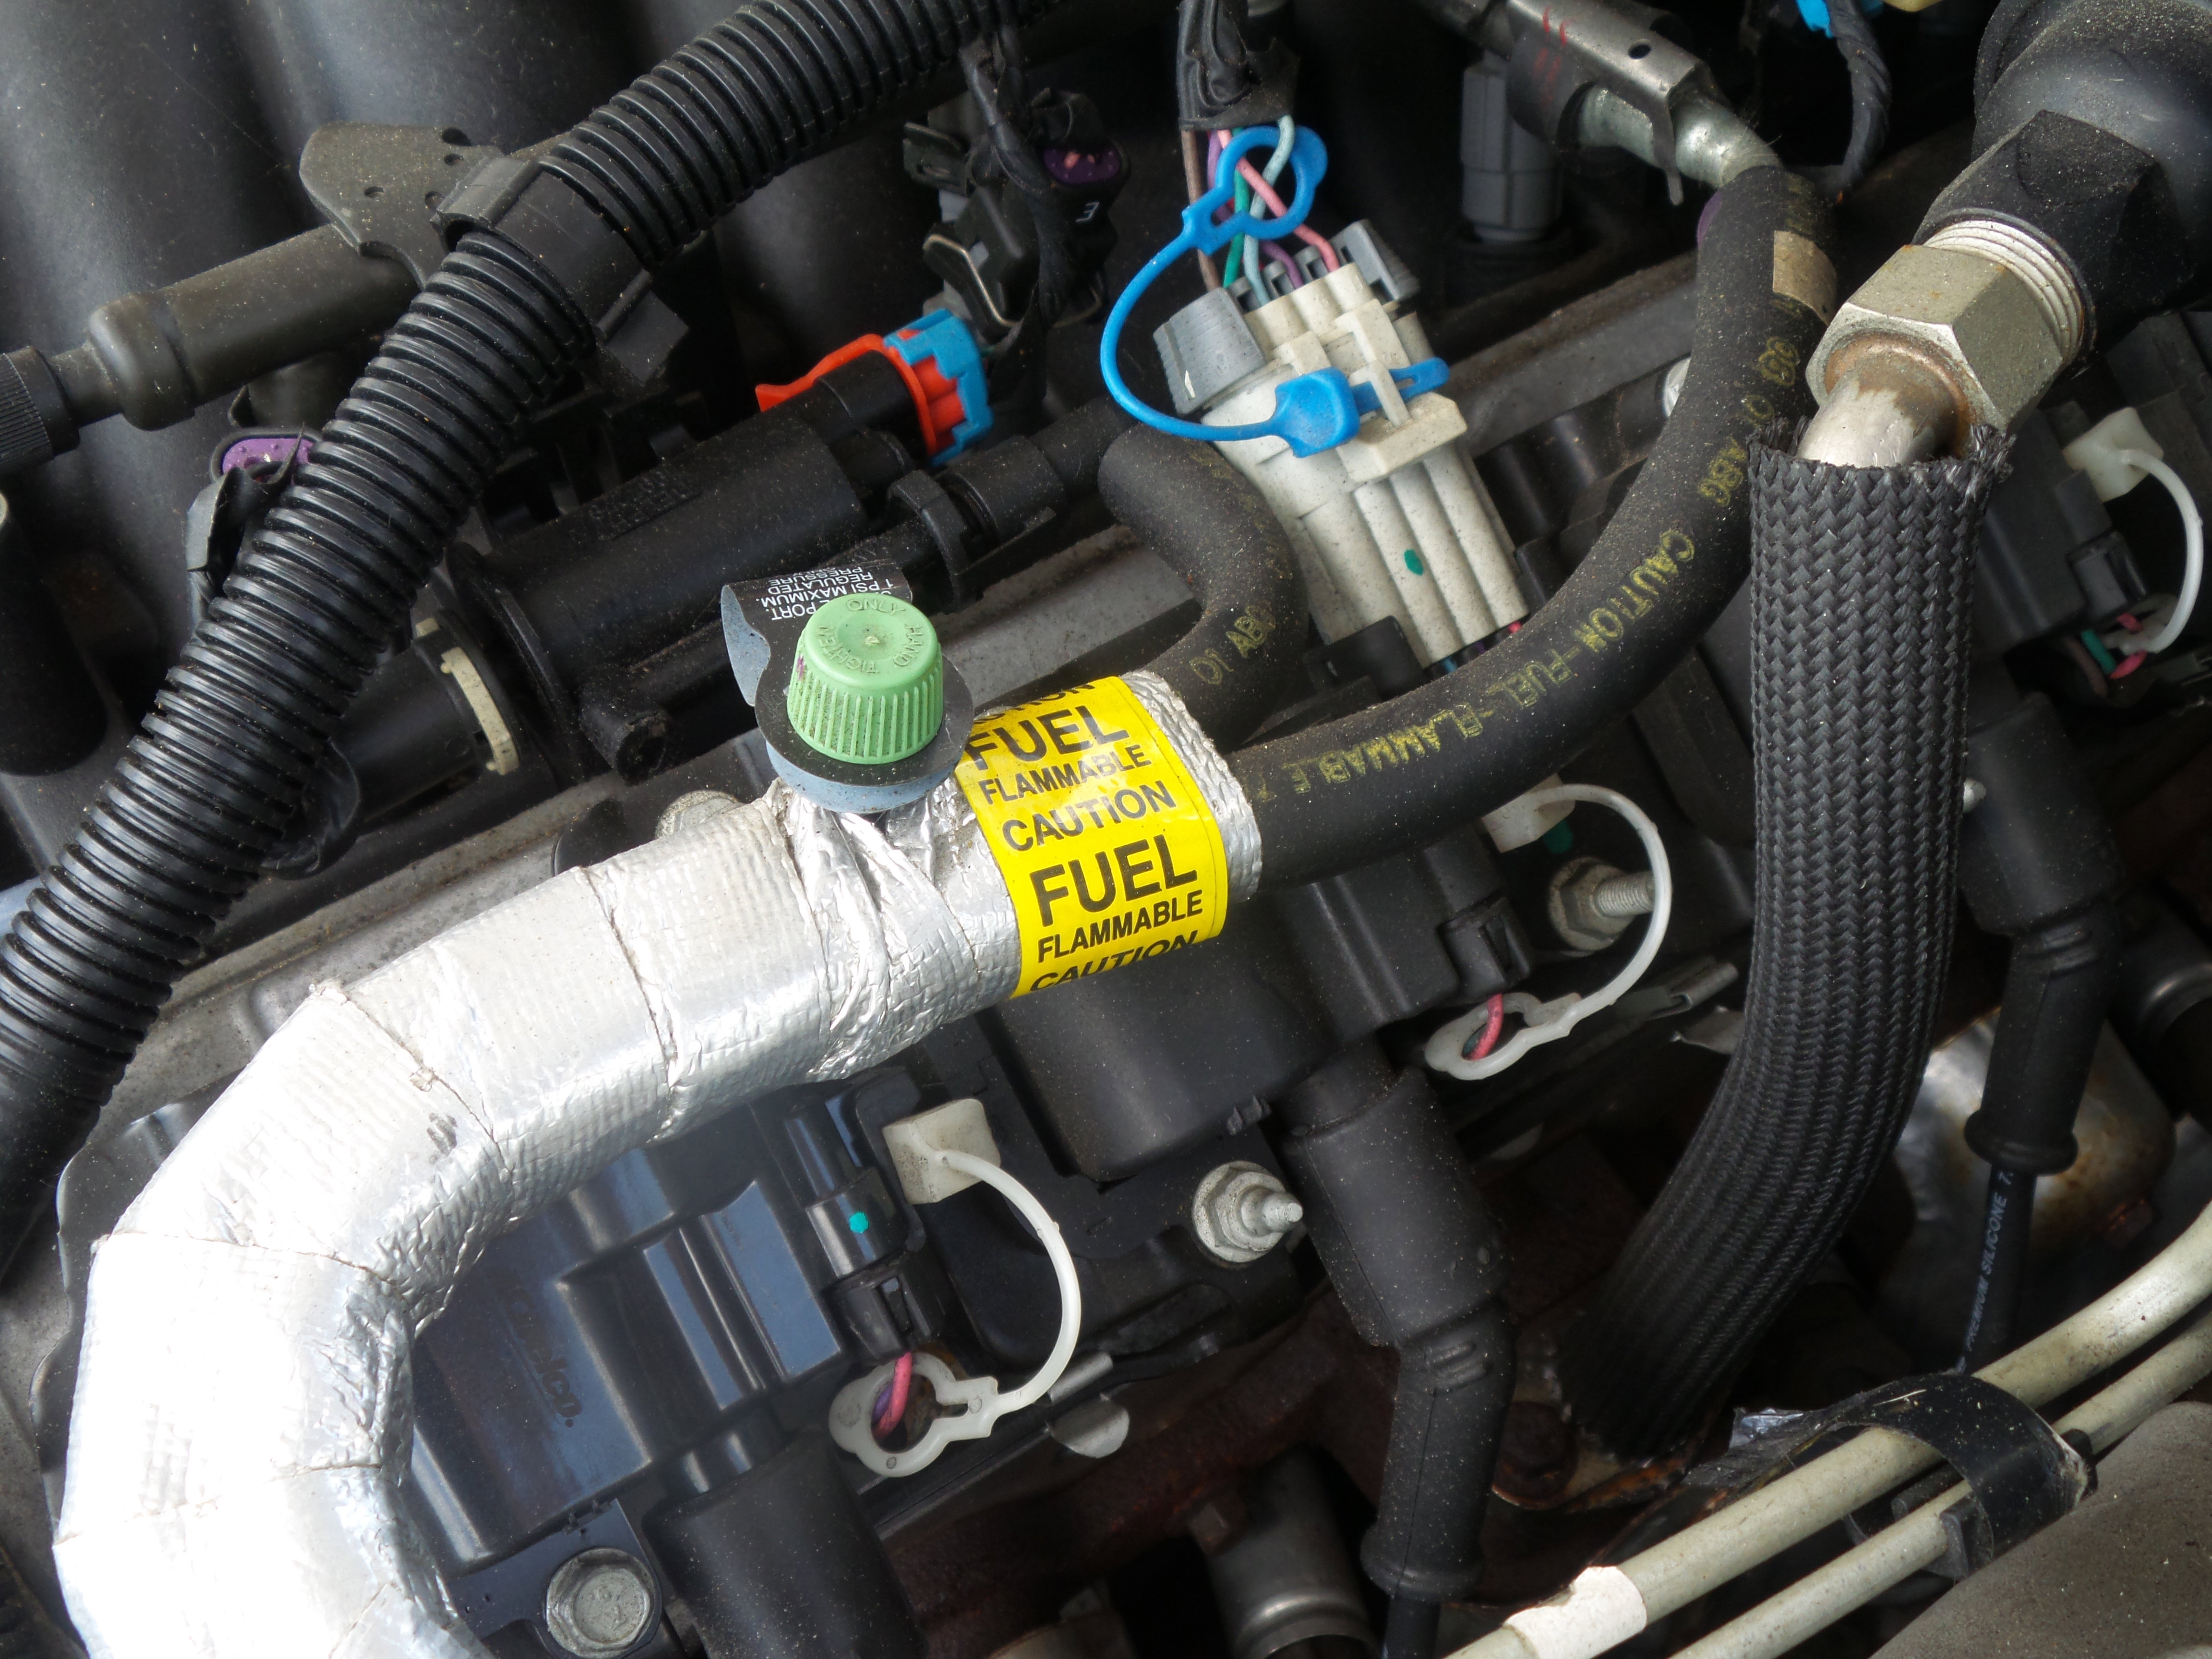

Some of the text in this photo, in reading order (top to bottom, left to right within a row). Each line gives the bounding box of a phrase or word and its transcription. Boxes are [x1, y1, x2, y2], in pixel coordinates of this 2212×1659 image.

[756, 583, 847, 608] MAXIMUM.
[768, 566, 863, 587] PRESSURE
[768, 571, 873, 594] REGULATED
[852, 580, 880, 593] PSI
[885, 578, 894, 588] 1
[817, 598, 924, 674] HAND TIGHTEN ONLY
[964, 705, 1130, 771] FUEL
[979, 744, 1152, 805] FLAMMABLE
[1002, 780, 1177, 852] CAUTION
[1029, 834, 1198, 927] FUEL
[1037, 890, 1203, 963] FLAMMABLE
[1030, 930, 1199, 993] CAUTION
[1981, 1193, 2008, 1274] SILICONE
